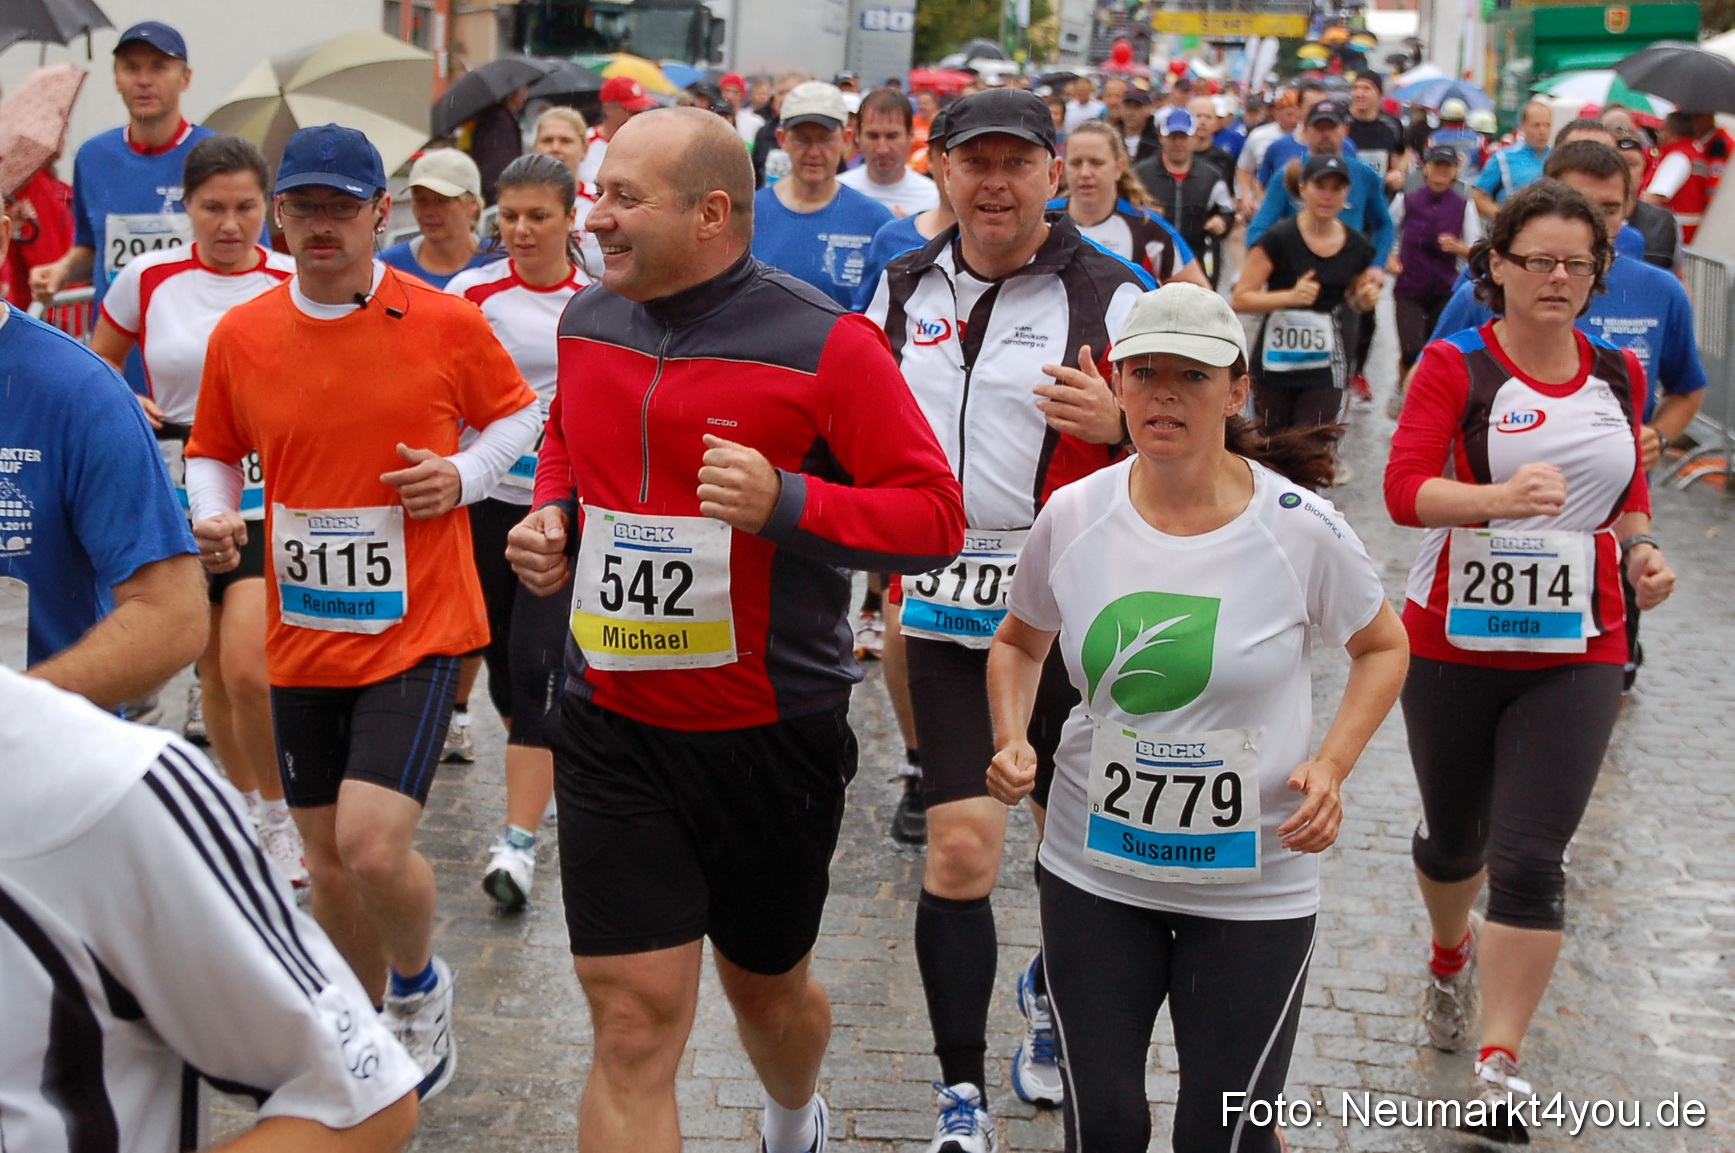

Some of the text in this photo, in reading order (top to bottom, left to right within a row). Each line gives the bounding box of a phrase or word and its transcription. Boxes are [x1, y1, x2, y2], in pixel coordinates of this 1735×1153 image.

[1272, 327, 1325, 350] 3005
[1502, 411, 1534, 425] tkn
[0, 447, 42, 462] RKTER
[308, 516, 360, 529] BOCK
[613, 522, 675, 543] BOCK
[1304, 503, 1342, 539] Bionorica
[964, 537, 1002, 551] OCK
[1490, 537, 1545, 549] BOCK
[284, 539, 392, 587] 3115
[600, 554, 694, 617] 542
[915, 562, 1016, 606] 310
[1463, 560, 1573, 607] 2814
[303, 593, 375, 616] Reinhard
[933, 610, 1000, 633] Thomas
[1488, 616, 1540, 634] Gerda
[603, 625, 689, 650] Michael
[1136, 741, 1206, 759] BOCK
[1104, 762, 1242, 828] 2779
[1122, 832, 1217, 862] Susanne
